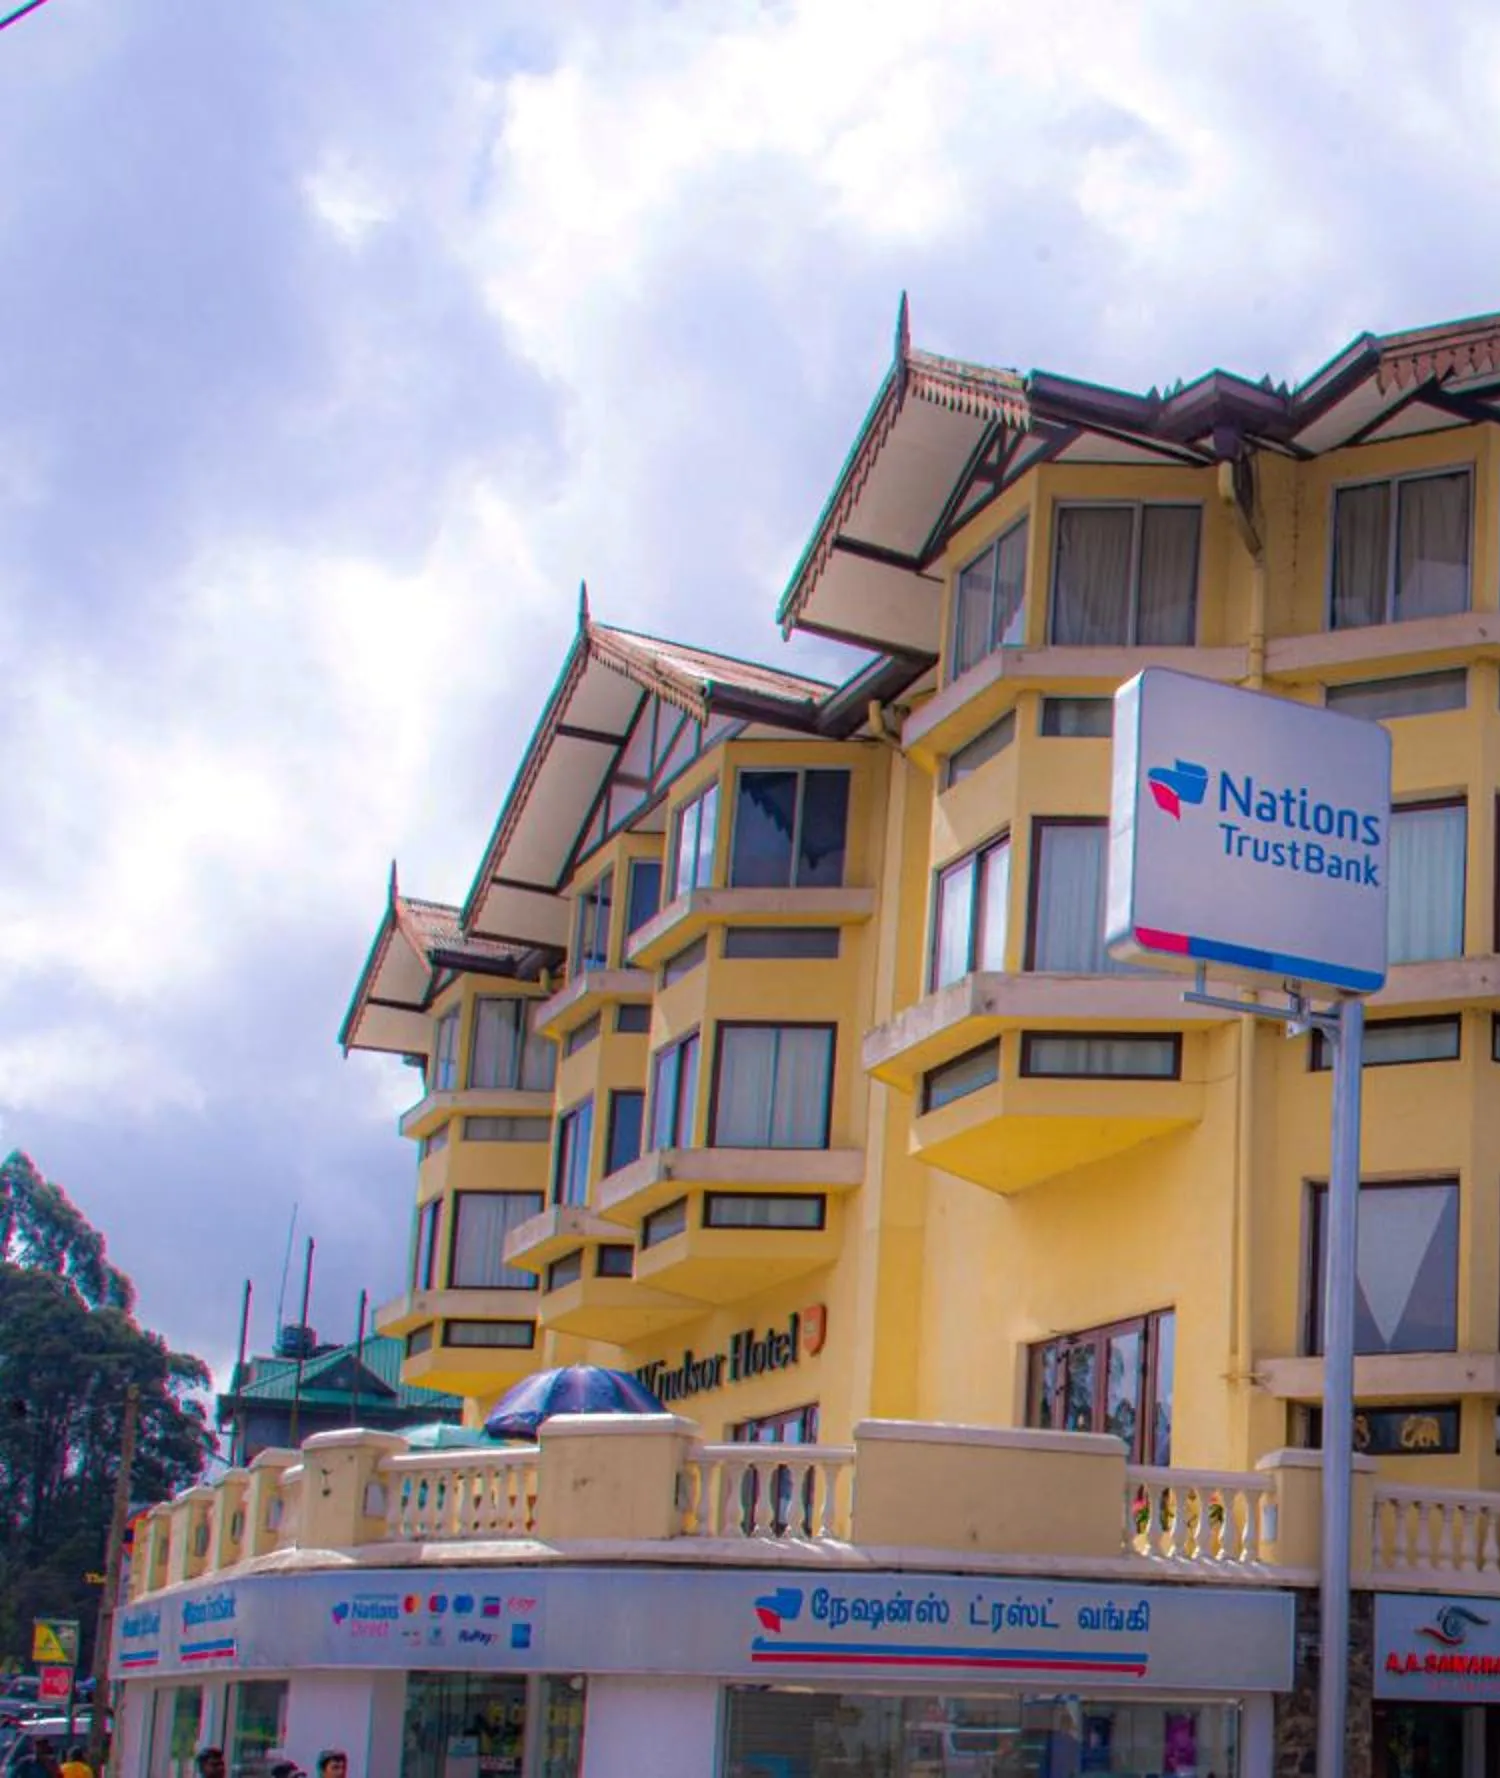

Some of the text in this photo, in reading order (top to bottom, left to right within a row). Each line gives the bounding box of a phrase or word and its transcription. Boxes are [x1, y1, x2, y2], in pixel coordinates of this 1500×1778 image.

[1219, 771, 1381, 846] Nations
[1218, 822, 1380, 887] TrustBank
[636, 1311, 800, 1403] Windsor Hotel
[351, 1602, 399, 1620] Nations
[811, 1587, 1150, 1634] நேஷன்ஸ் ட்ரஸ்ட் வங்கி
